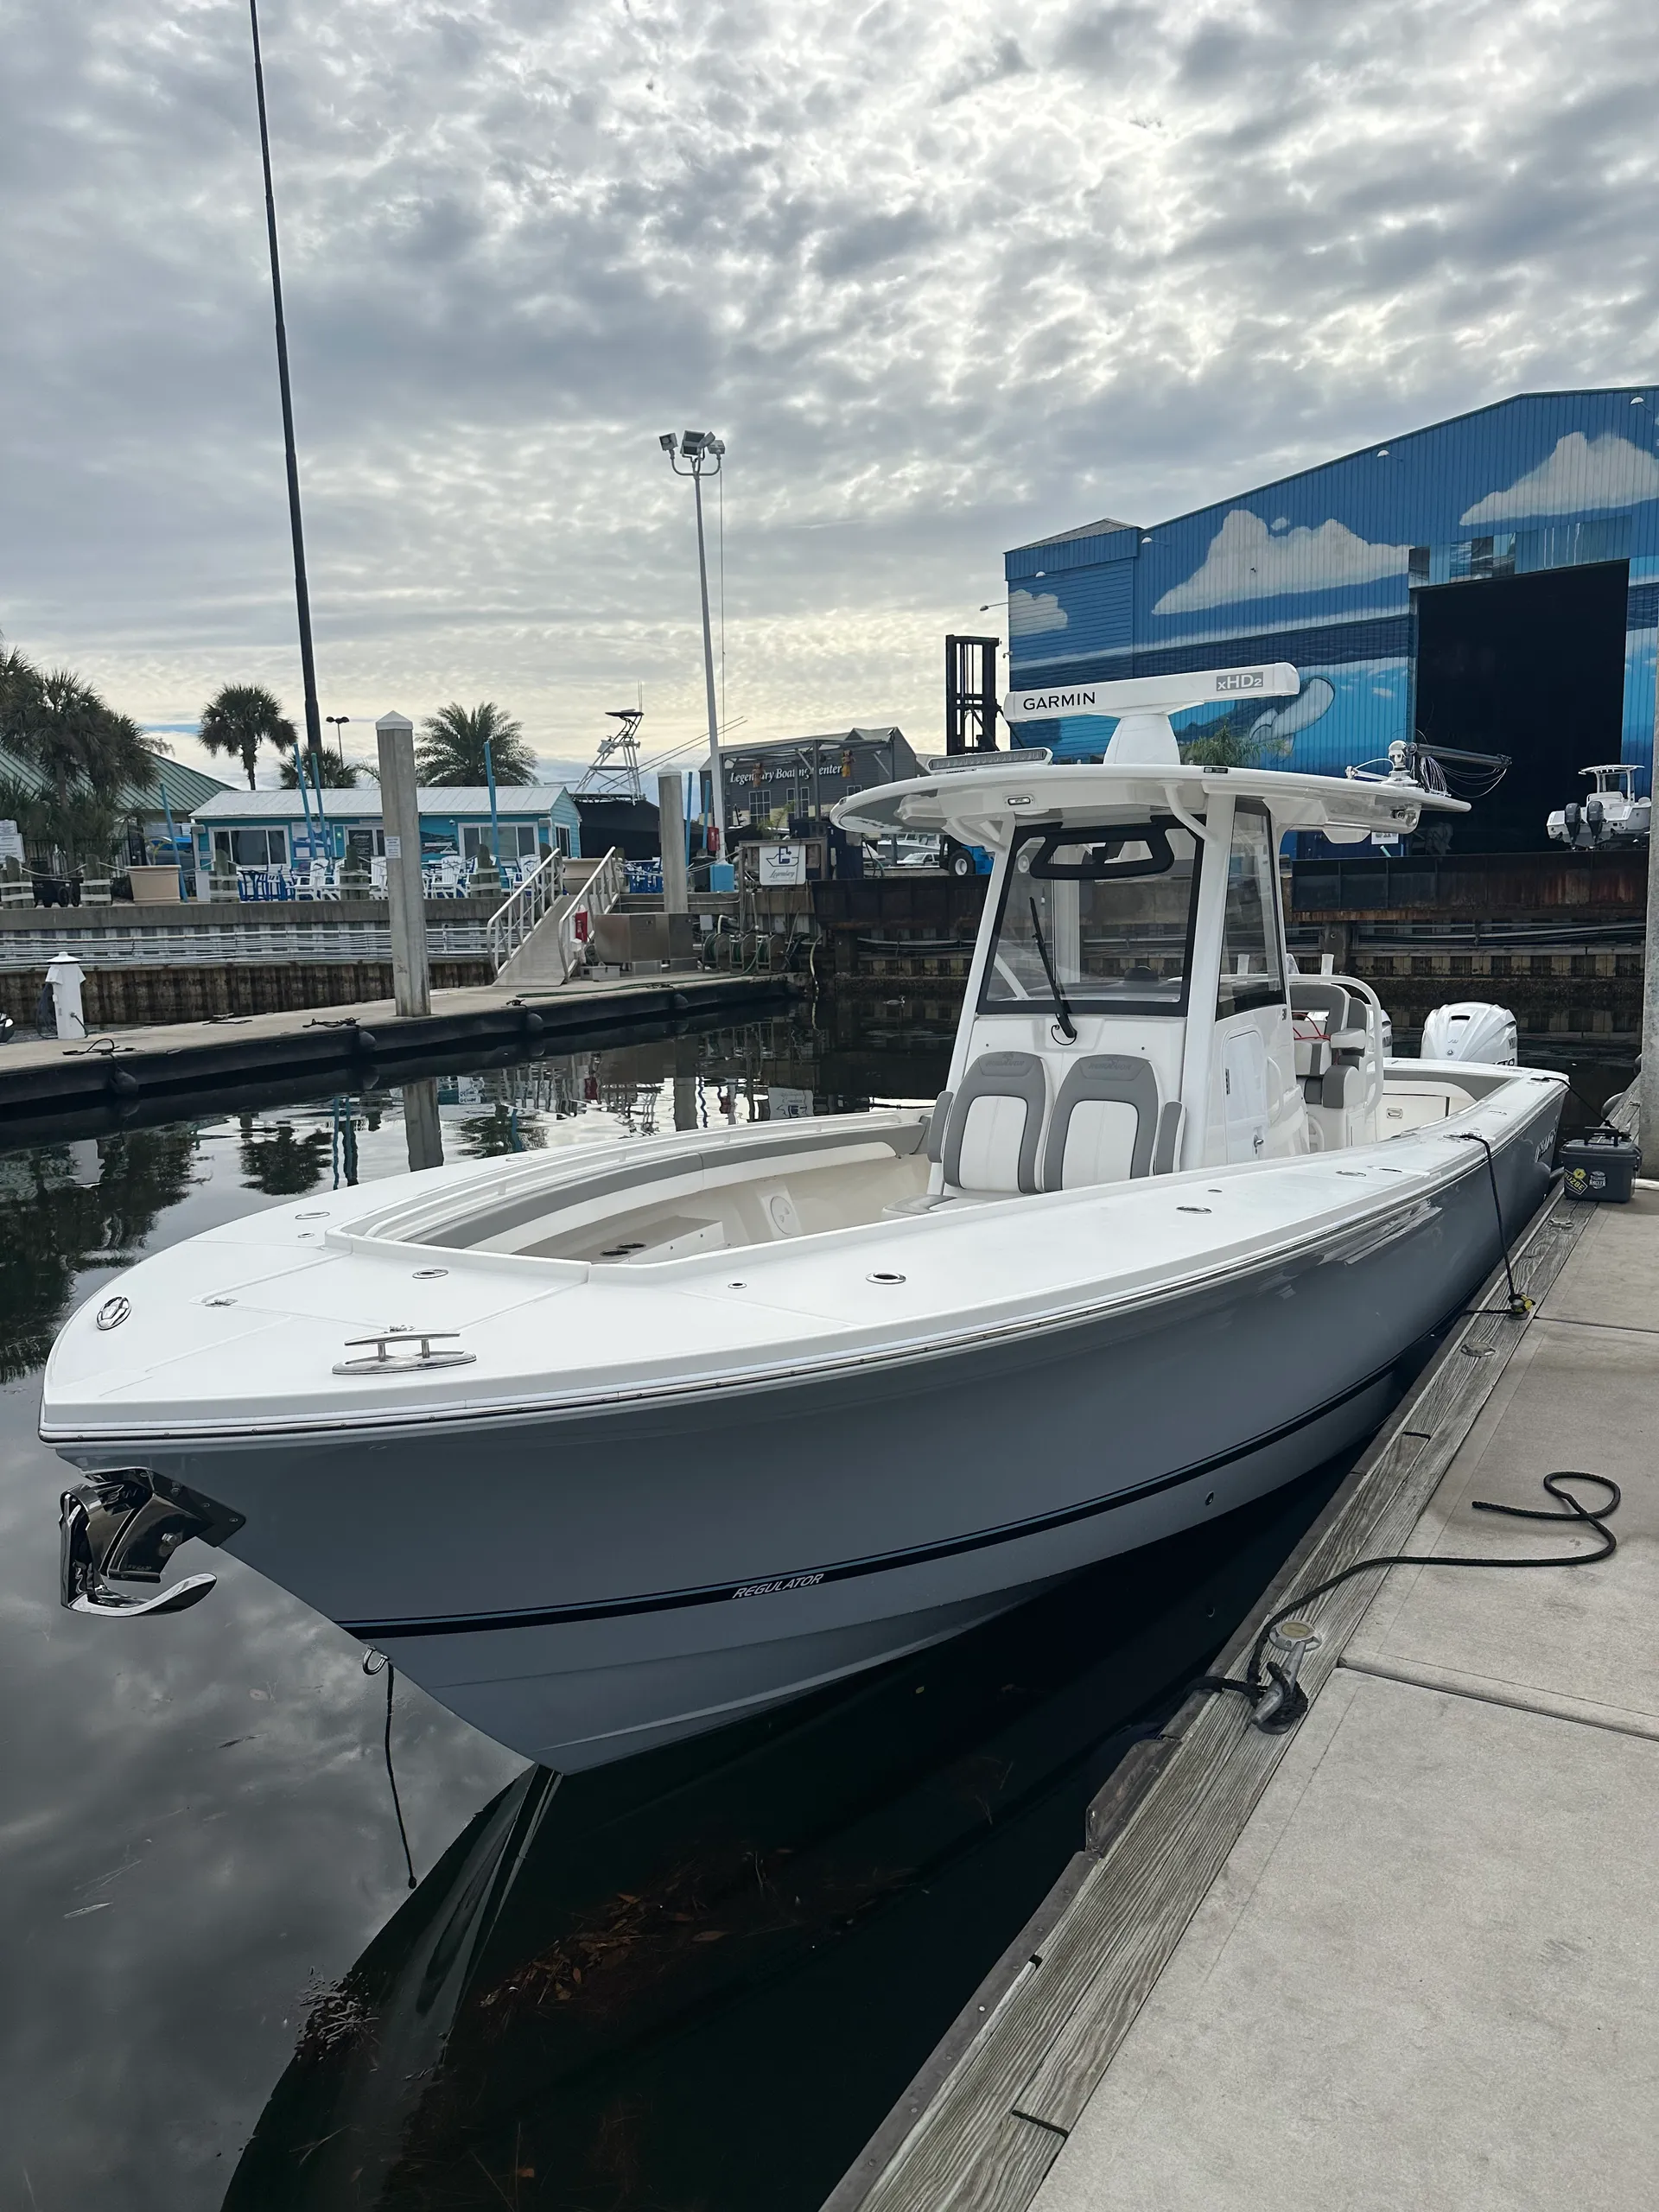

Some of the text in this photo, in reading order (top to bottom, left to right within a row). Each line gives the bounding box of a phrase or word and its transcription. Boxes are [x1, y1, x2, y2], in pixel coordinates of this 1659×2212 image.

[1023, 691, 1096, 711] GARMIN
[730, 772, 774, 785] Legenary
[811, 765, 842, 776] enter
[732, 1574, 824, 1599] REGULATOR
